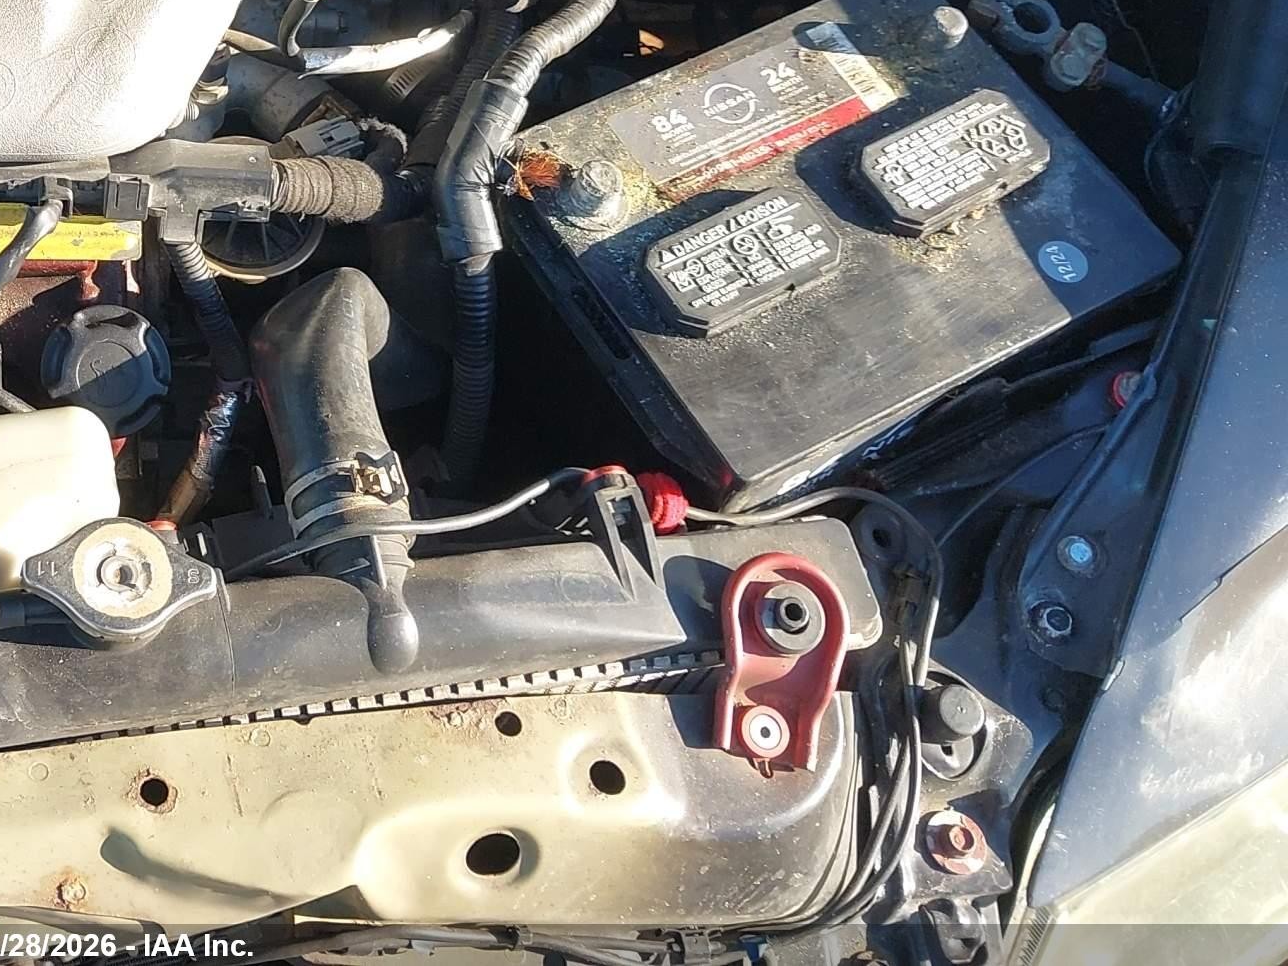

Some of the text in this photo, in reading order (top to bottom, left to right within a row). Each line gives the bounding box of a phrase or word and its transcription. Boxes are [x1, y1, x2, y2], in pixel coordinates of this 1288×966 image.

[760, 62, 797, 87] 24
[703, 89, 757, 117] NISSAN
[651, 108, 690, 133] 84
[672, 223, 730, 256] DANGER
[736, 196, 789, 227] POISON
[1045, 245, 1077, 281] 12/24
